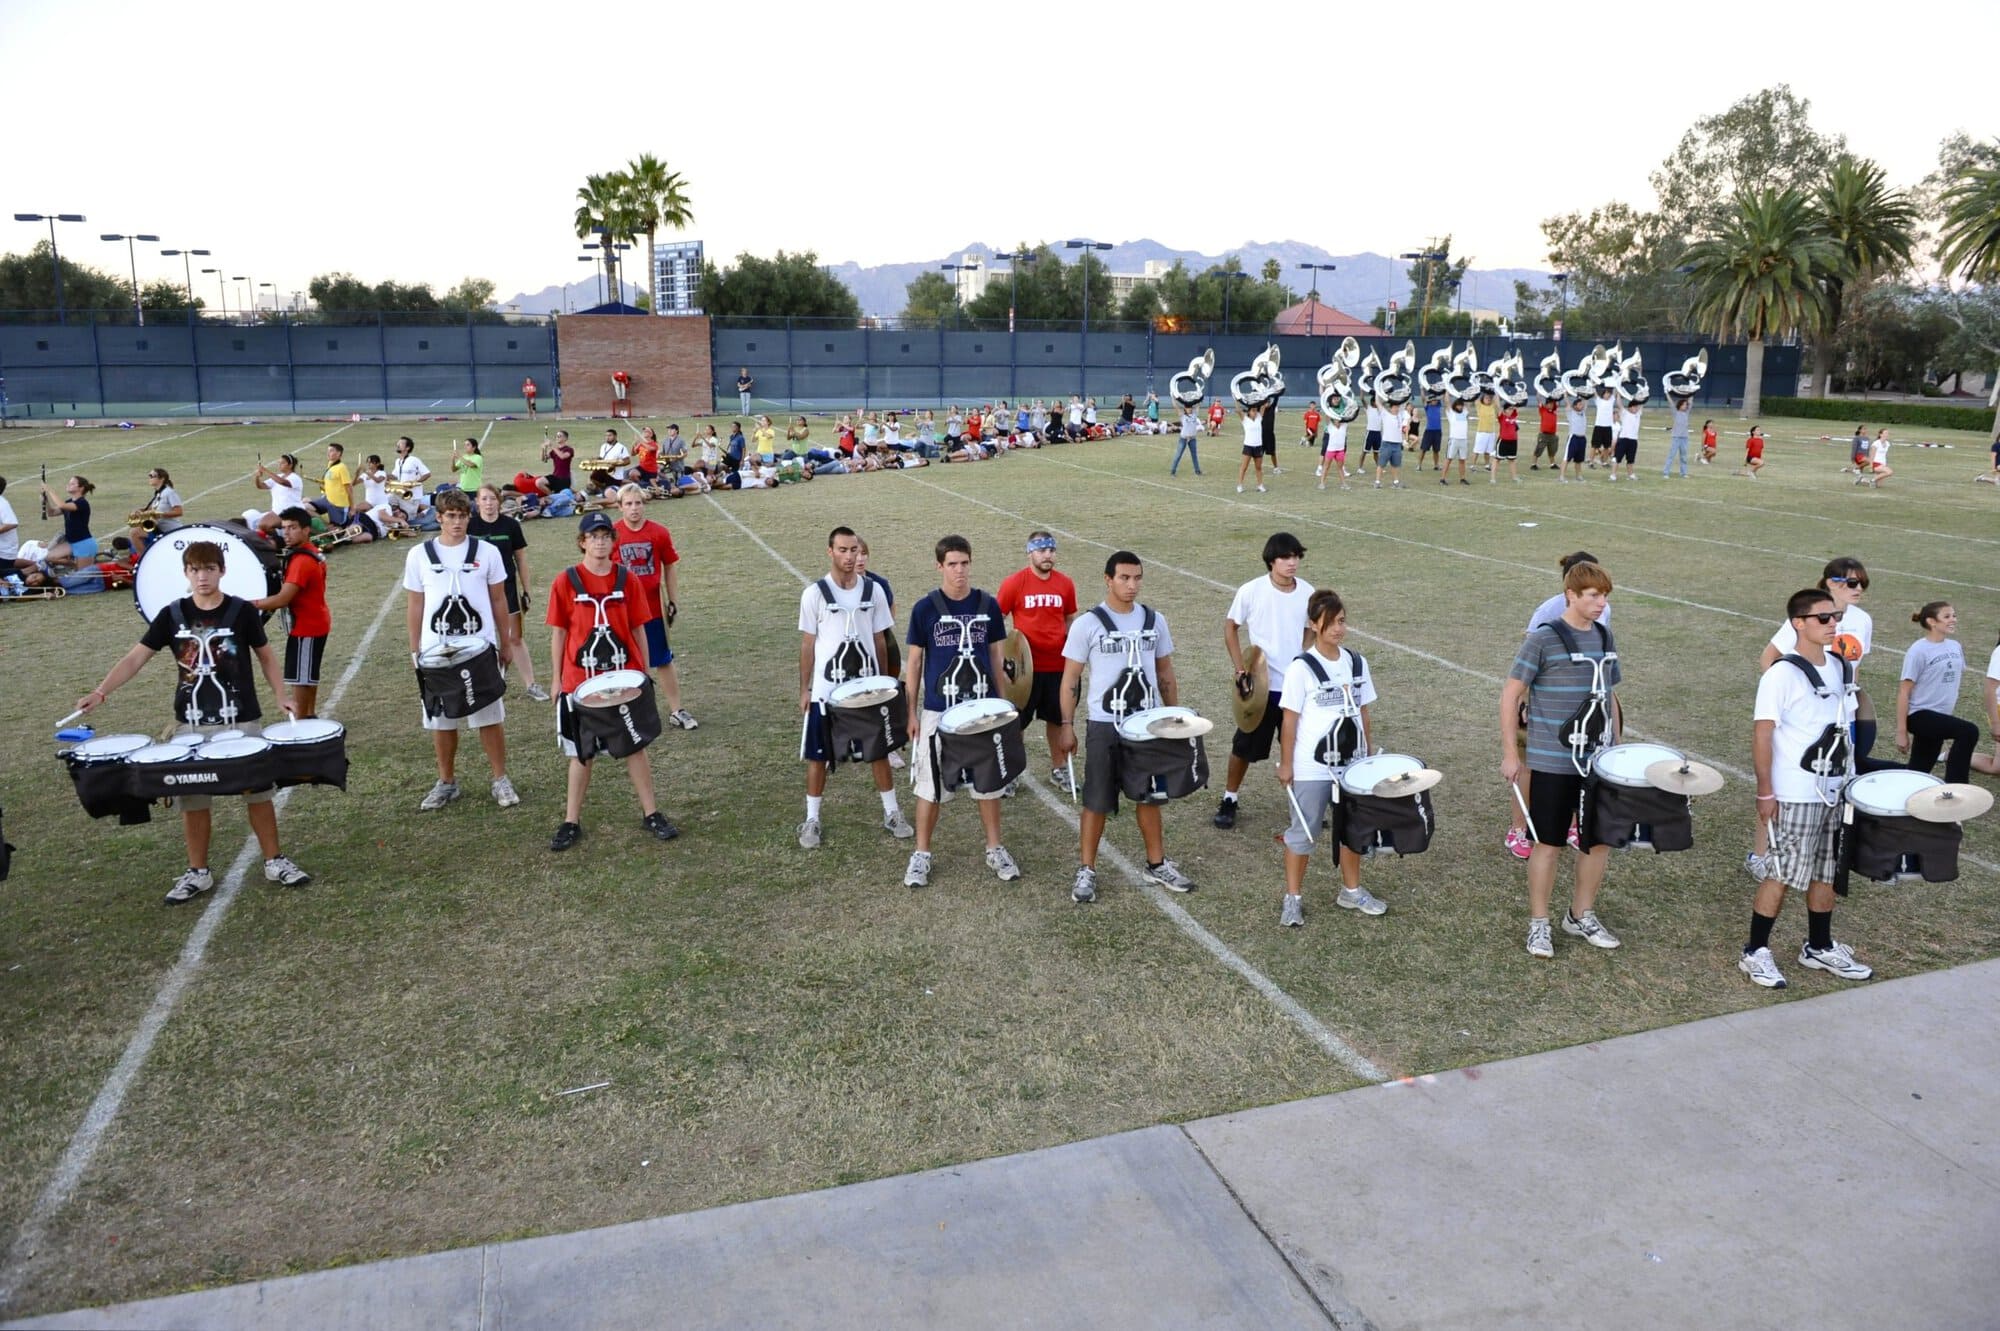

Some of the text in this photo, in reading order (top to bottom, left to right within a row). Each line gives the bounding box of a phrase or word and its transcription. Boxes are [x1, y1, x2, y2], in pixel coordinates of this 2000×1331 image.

[1024, 594, 1063, 609] BTFD
[623, 711, 642, 744] YAMAHA
[175, 772, 219, 785] YAMAHA
